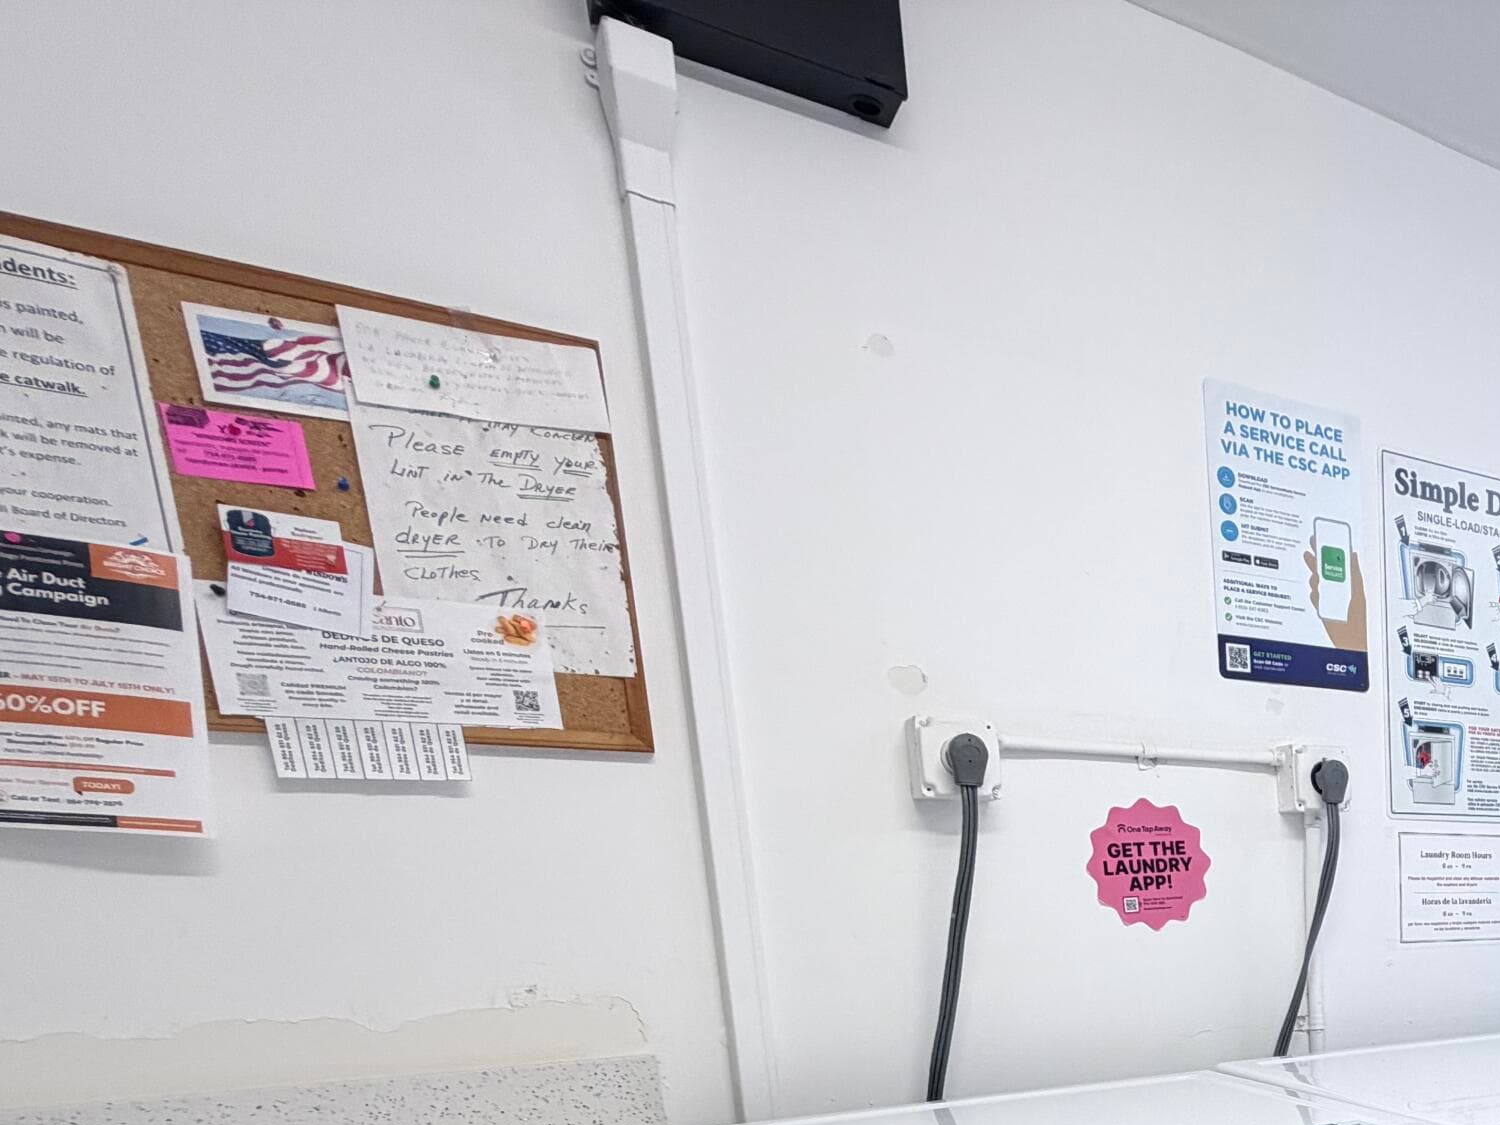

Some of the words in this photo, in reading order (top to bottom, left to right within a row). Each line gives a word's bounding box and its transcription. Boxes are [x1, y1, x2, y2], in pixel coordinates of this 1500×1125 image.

[0, 258, 76, 285] dents:
[16, 302, 84, 324] painted.
[11, 326, 38, 339] will
[43, 330, 65, 344] be
[12, 351, 95, 373] regulation
[100, 365, 115, 376] of
[15, 374, 87, 394] catwalk.
[47, 421, 71, 432] any
[75, 425, 108, 436] mats
[111, 429, 138, 441] that
[1226, 401, 1265, 423] HOW
[1270, 412, 1291, 430] TO
[1296, 419, 1343, 443] PLACE
[12, 433, 37, 443] will
[40, 436, 58, 446] be
[61, 439, 121, 455] removed
[124, 449, 139, 457] at
[1224, 421, 1235, 436] A
[1240, 425, 1305, 452] SERVICE
[1309, 442, 1347, 462] CALL
[19, 450, 82, 465] expense.
[1221, 439, 1250, 459] VIA
[1254, 447, 1285, 466] THE
[1288, 456, 1318, 473] CSC
[1322, 463, 1351, 480] APP
[31, 490, 112, 507] cooperation.
[1395, 467, 1480, 514] Simple
[11, 506, 51, 519] Board
[54, 512, 67, 520] of
[7, 568, 38, 583] Air
[42, 572, 87, 589] Duct
[7, 583, 111, 608] Campaign
[320, 643, 379, 653] Hand-Rolled
[382, 647, 415, 655] Cheese
[418, 650, 454, 658] Pastries
[382, 636, 399, 644] DE
[402, 637, 445, 647] QUESO
[1326, 663, 1347, 673] CSC
[1108, 842, 1145, 858] GET
[1149, 841, 1186, 856] THE
[1421, 851, 1449, 860] Laundry
[1451, 851, 1471, 859] Room
[1104, 857, 1192, 876] LAUNDRY
[1130, 875, 1173, 892] APP!
